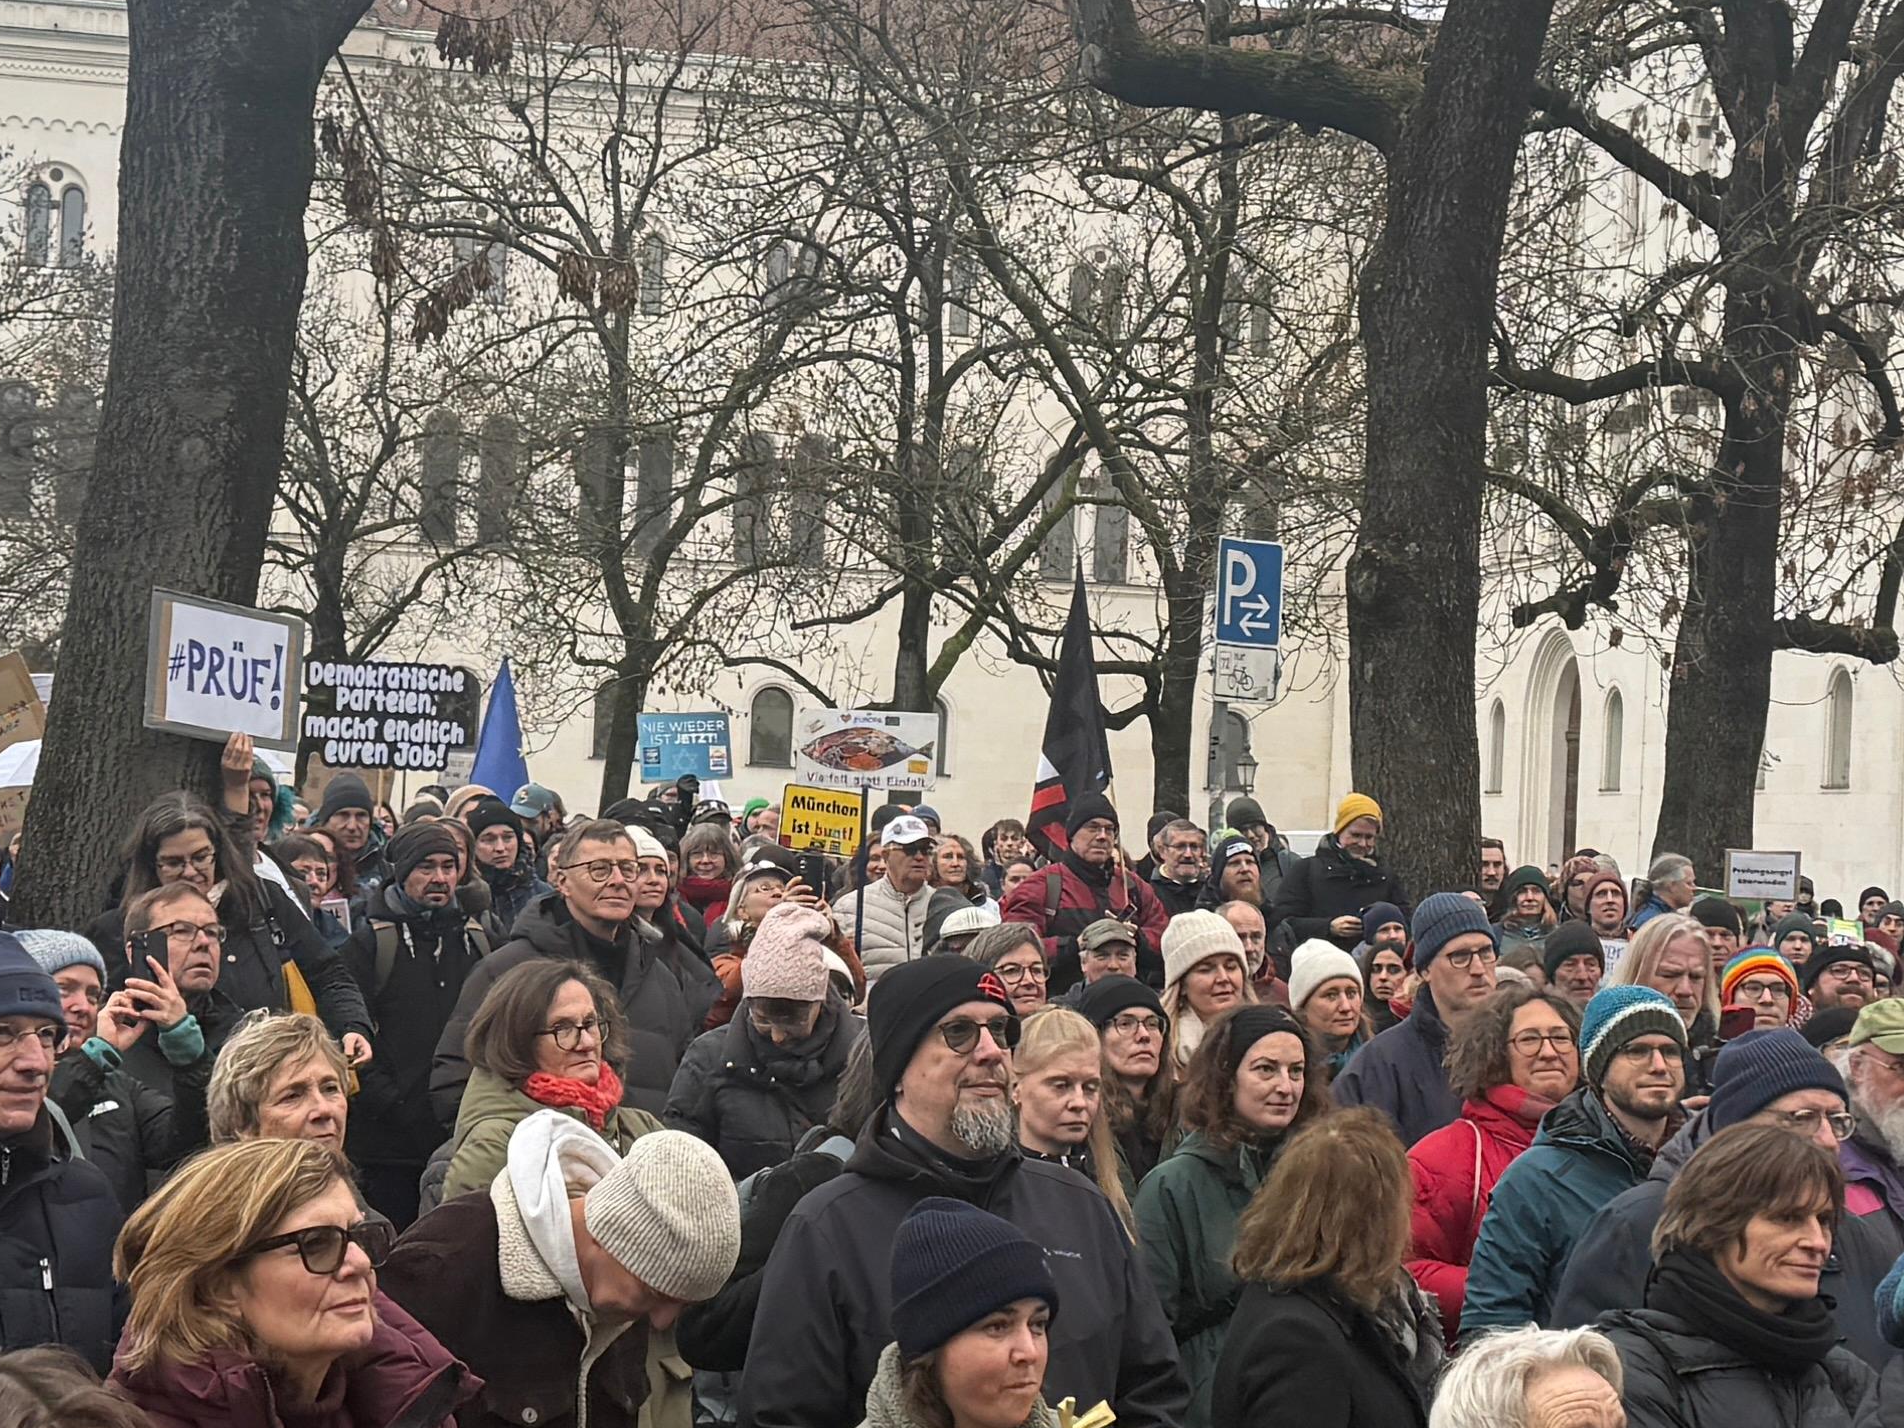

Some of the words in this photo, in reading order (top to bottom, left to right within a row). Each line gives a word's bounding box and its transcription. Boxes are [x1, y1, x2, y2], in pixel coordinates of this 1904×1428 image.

[1223, 548, 1257, 626] P
[168, 638, 284, 711] #PRÜF!
[309, 661, 465, 693] Demokratische
[336, 687, 437, 716] Parteien,
[305, 716, 378, 740] macht
[383, 718, 465, 744] endlich
[642, 722, 665, 733] NIE
[668, 720, 725, 732] WIEDER
[650, 734, 672, 745] IST
[674, 733, 718, 744] JETZT!
[324, 740, 389, 764] euren
[394, 741, 446, 767] Job!
[807, 772, 848, 784] Vielfalt
[886, 776, 925, 787] Einfalt
[791, 795, 859, 817] München
[792, 819, 810, 834] ist
[814, 821, 853, 841] bunt!
